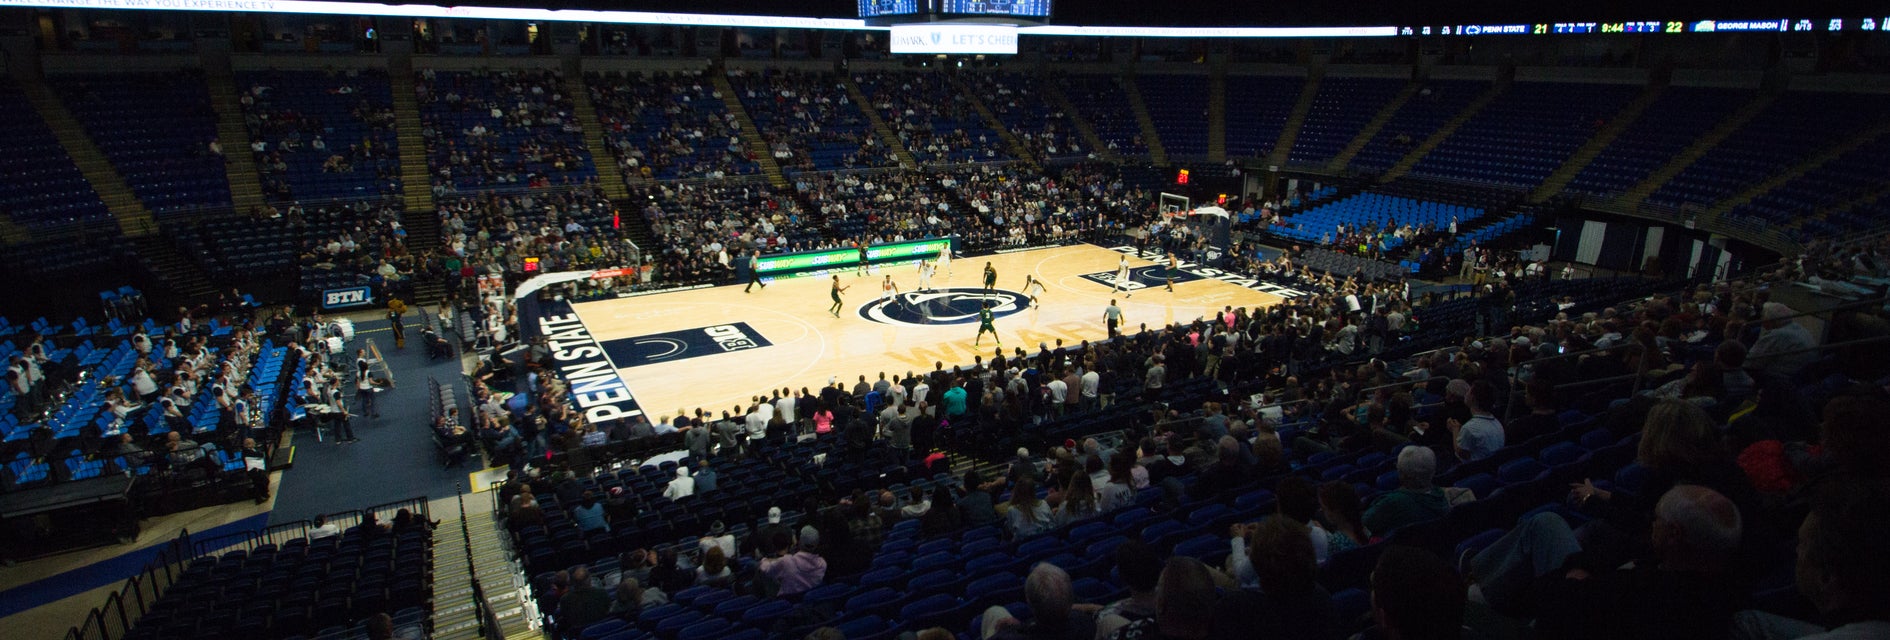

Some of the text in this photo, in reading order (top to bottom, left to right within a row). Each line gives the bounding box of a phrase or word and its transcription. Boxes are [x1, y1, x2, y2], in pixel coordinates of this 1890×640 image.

[184, 0, 257, 9] EXPERIENCE
[1482, 25, 1525, 33] PENN STATE
[1534, 23, 1548, 34] 21
[1601, 22, 1624, 33] 9:44
[1666, 21, 1683, 33] 22
[1717, 21, 1778, 30] GEORGE MASON
[952, 35, 984, 45] LET'S
[758, 259, 795, 270] SUBWAY
[812, 253, 848, 265] SUBWAY
[1190, 267, 1307, 298] STATE
[327, 290, 364, 304] BTN
[538, 312, 601, 361] STATE
[560, 360, 643, 424] PENN
